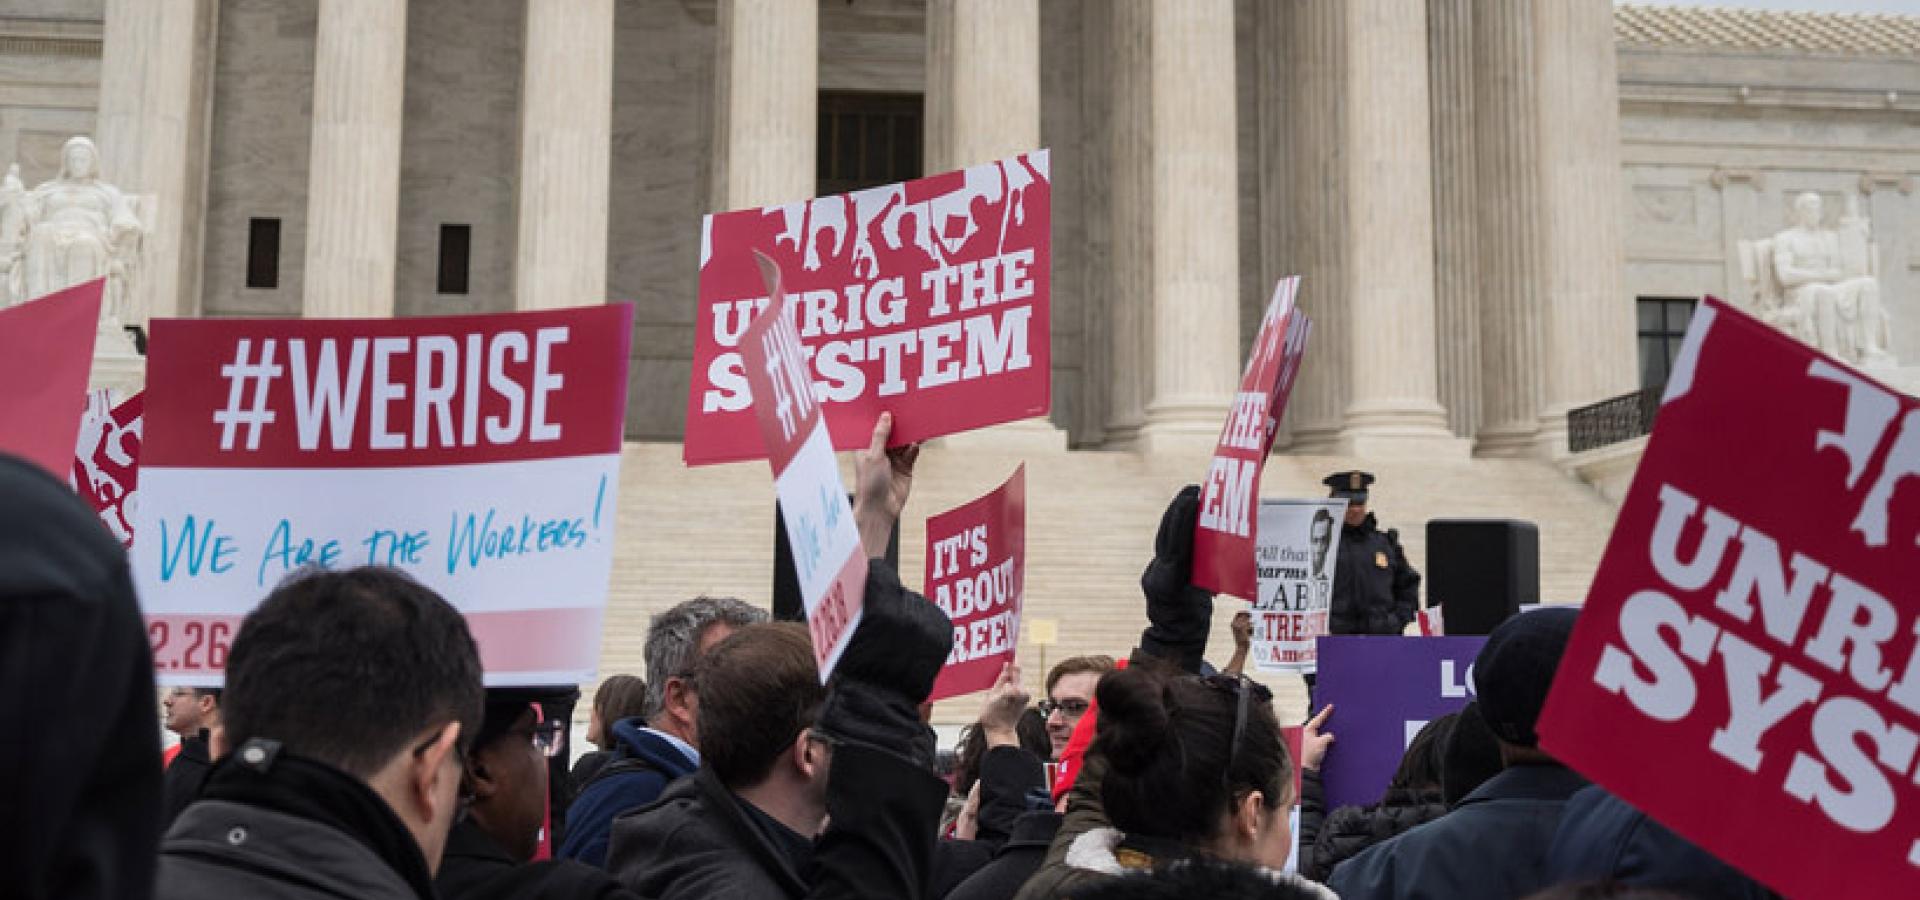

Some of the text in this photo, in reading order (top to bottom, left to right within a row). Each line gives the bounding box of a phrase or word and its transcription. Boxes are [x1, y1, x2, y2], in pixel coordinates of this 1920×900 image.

[921, 248, 1035, 318] THE
[212, 326, 570, 452] #WERISE
[703, 305, 1032, 414] SSTEM
[932, 524, 988, 580] IT'S
[935, 562, 1014, 620] ABOUT
[1594, 589, 1920, 868] SYS
